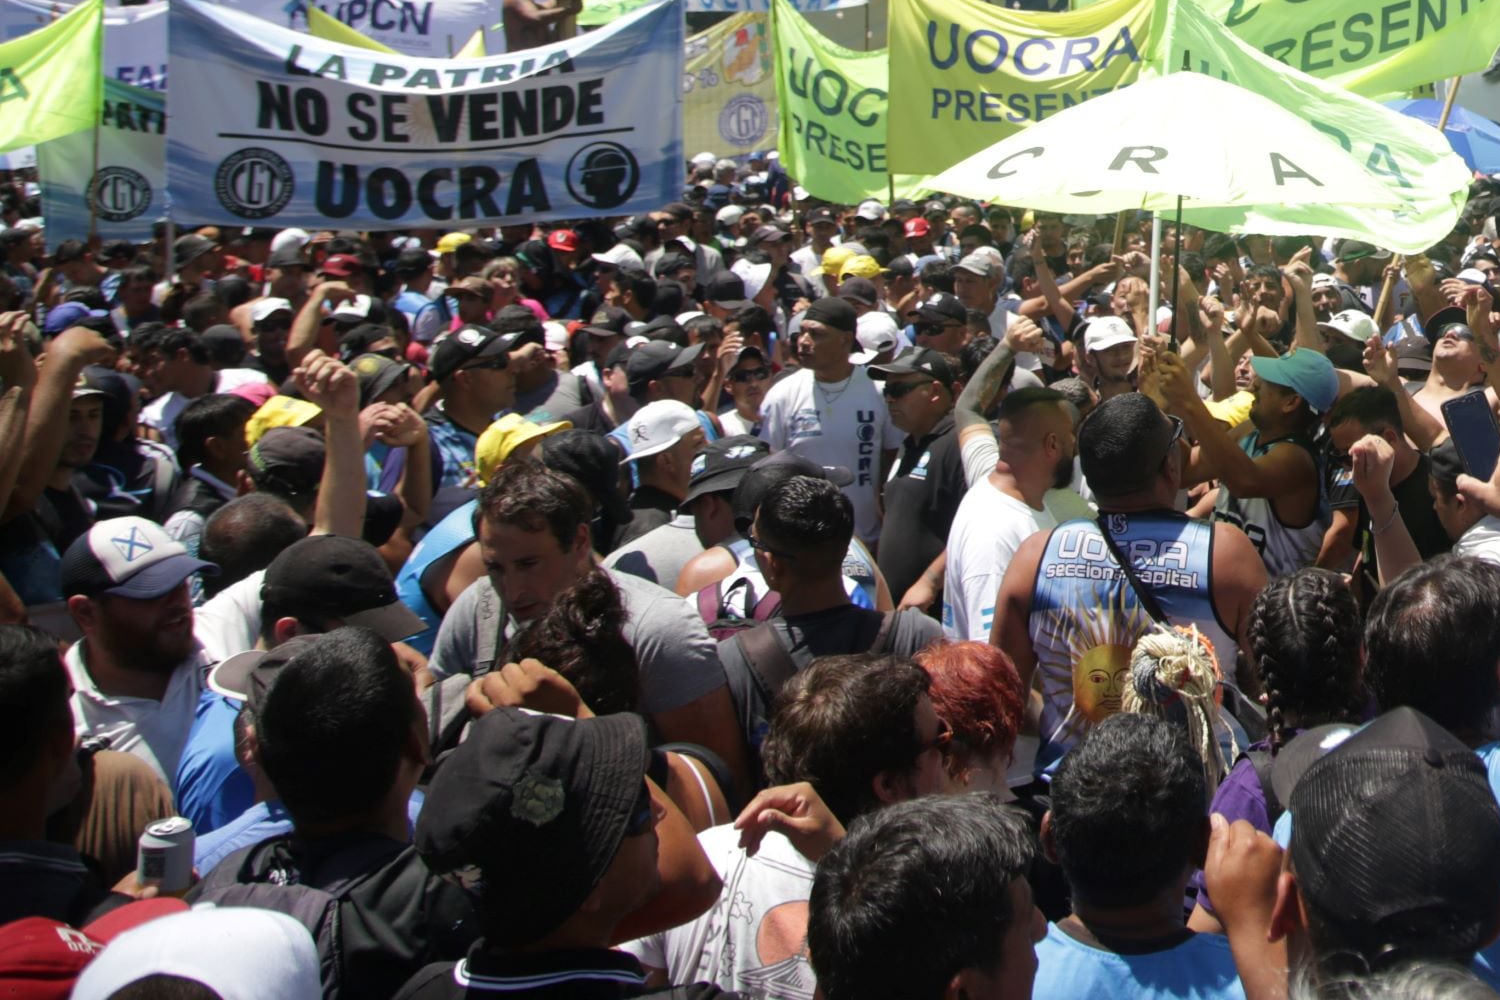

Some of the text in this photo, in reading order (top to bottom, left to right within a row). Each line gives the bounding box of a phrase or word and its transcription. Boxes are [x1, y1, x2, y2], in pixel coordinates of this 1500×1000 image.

[286, 44, 576, 90] LA PATRIA
[928, 20, 1141, 76] UOCRA
[256, 78, 604, 144] NO SE VENDE
[785, 47, 887, 128] UOC
[931, 84, 1134, 123] PRESEN
[315, 156, 551, 221] UOCRA
